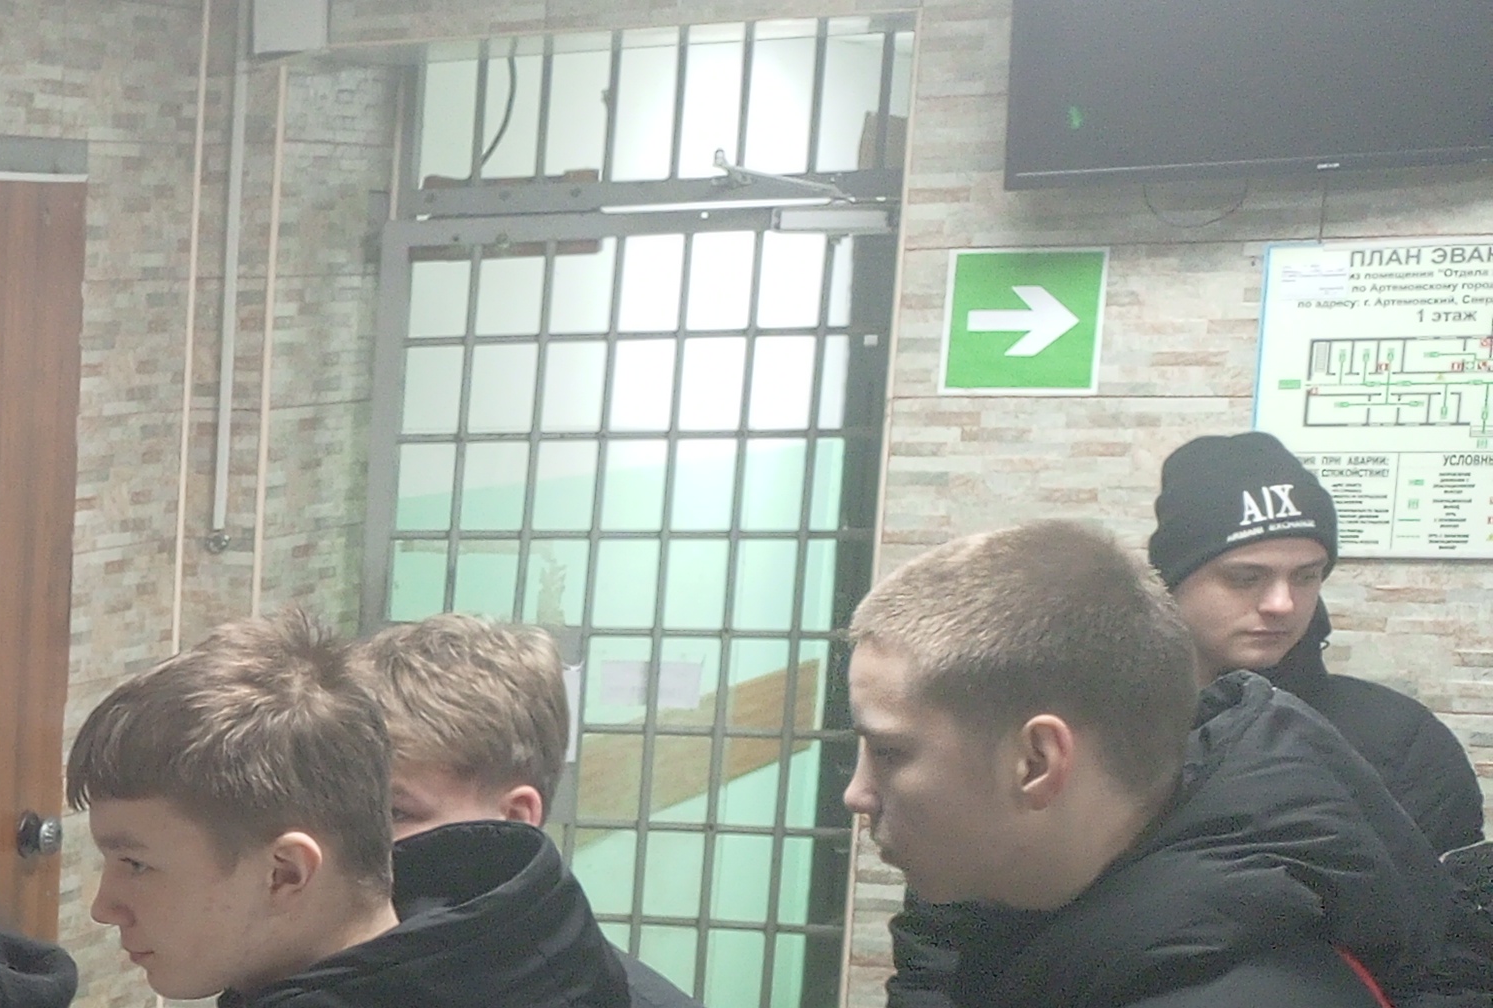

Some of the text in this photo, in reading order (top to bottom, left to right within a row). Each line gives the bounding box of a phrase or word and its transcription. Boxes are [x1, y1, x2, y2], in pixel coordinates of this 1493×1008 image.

[1349, 249, 1422, 268] ПЛАН
[1417, 309, 1477, 323] 1 этаж
